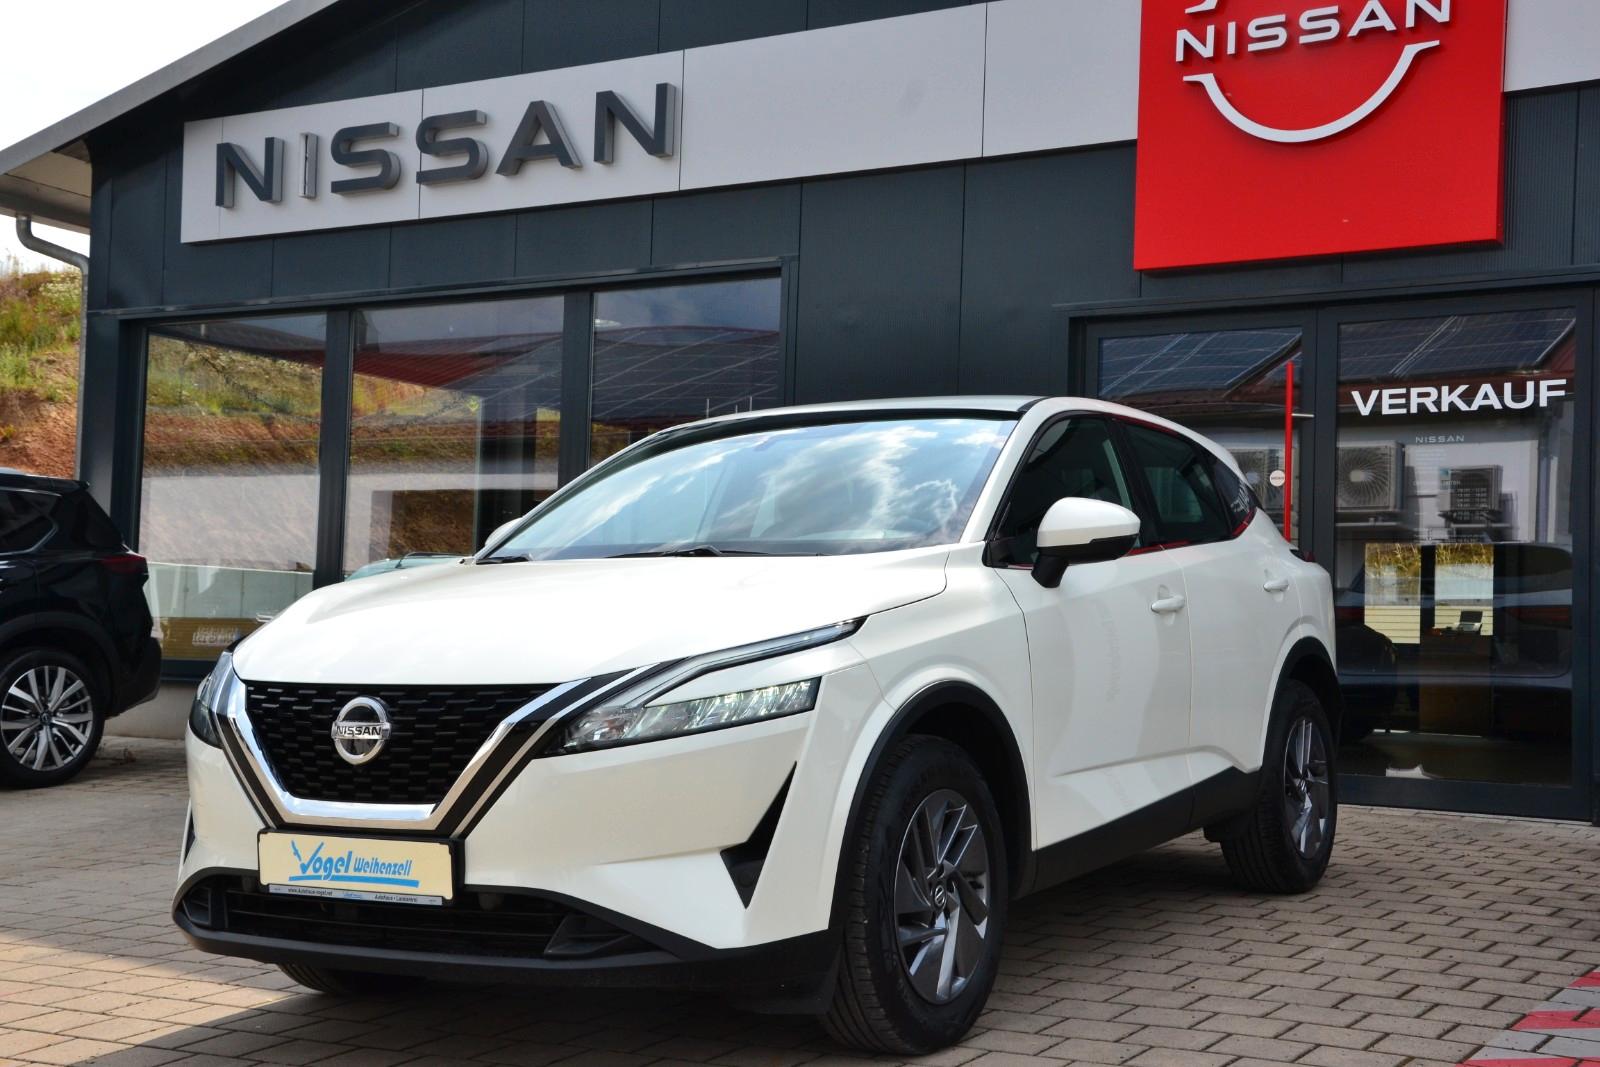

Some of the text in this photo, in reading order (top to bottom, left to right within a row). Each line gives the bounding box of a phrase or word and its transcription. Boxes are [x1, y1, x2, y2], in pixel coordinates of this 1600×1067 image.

[1175, 0, 1450, 62] NISSAN
[215, 82, 677, 209] NISSAN
[1351, 379, 1567, 416] VERKAUF
[1415, 435, 1465, 443] NISSAN
[336, 726, 382, 735] NISSAN
[291, 840, 412, 880] Vogel Weihenzell
